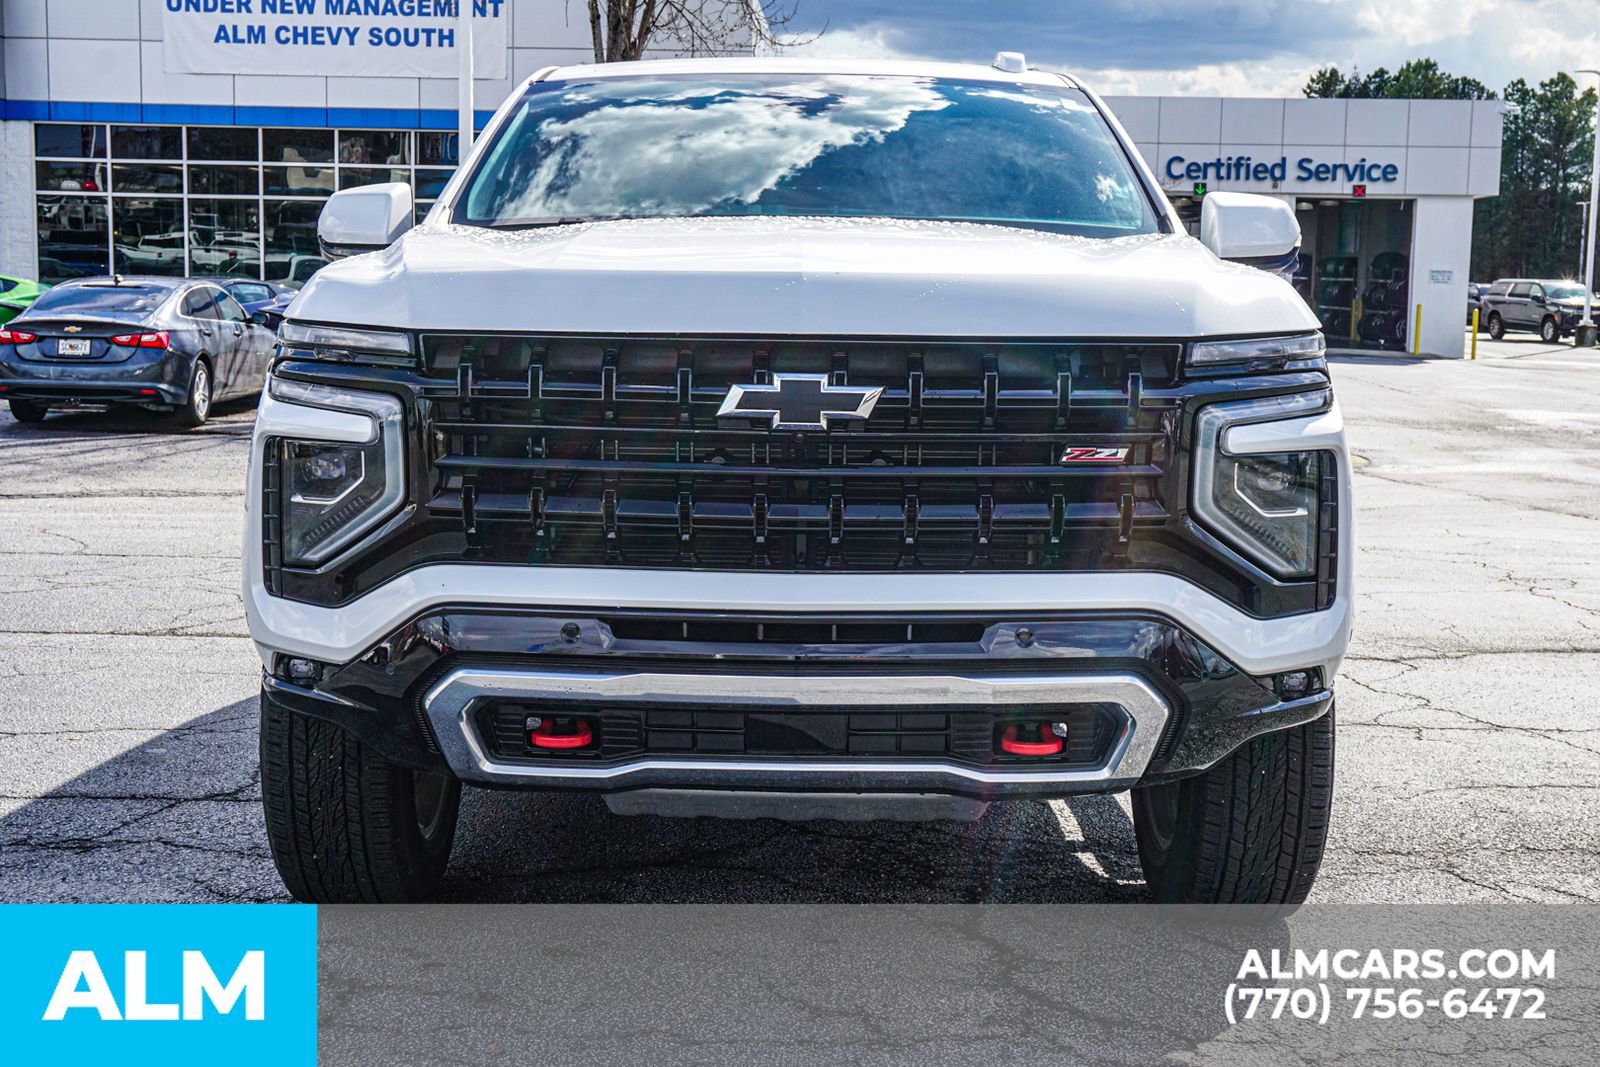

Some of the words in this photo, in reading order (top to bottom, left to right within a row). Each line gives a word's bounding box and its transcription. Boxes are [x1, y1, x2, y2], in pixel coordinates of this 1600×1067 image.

[166, 0, 253, 14] UNDER
[261, 0, 316, 15] NEW
[213, 24, 266, 44] ALM
[274, 25, 360, 46] CHEVY
[368, 27, 455, 48] SOUTH
[1166, 156, 1287, 182] Certified
[1296, 158, 1399, 183] Service
